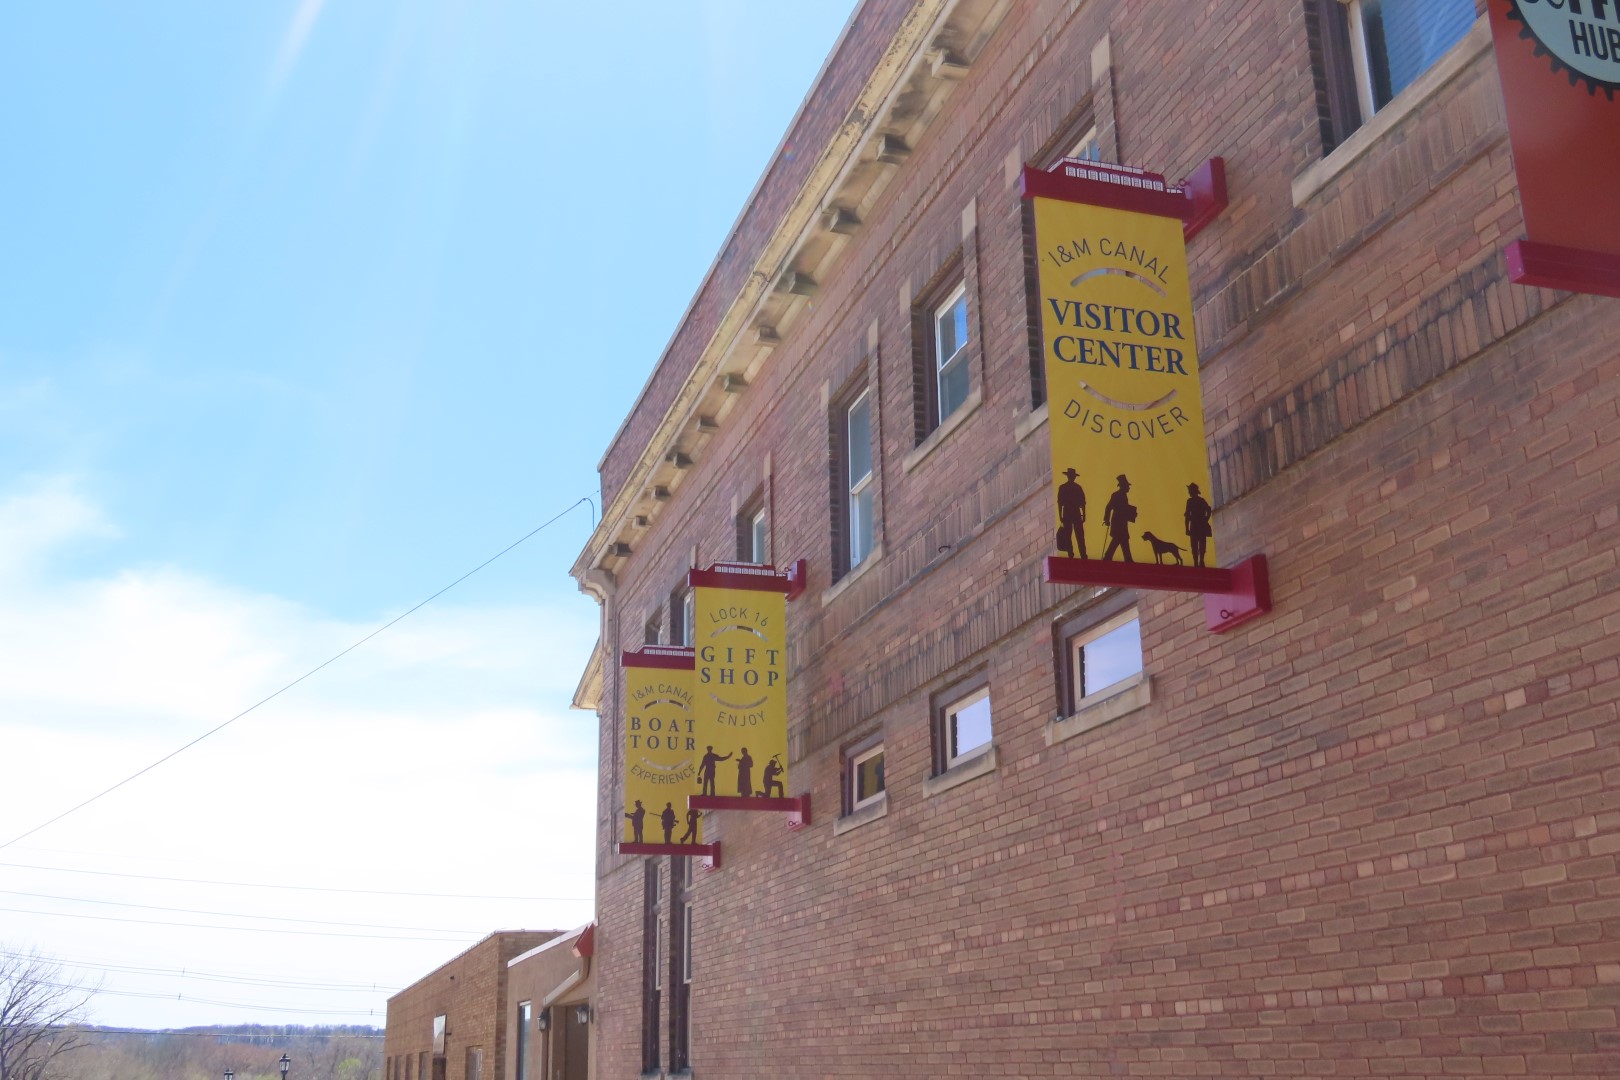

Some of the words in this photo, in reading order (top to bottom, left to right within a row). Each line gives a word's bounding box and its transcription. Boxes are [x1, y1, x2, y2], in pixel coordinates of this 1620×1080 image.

[1048, 238, 1091, 267] I&M
[1099, 238, 1169, 284] CANAL
[1047, 298, 1185, 340] VISITOR
[1053, 336, 1188, 376] CENTER
[1063, 399, 1189, 441] DISCOVER
[709, 607, 748, 623] LOCK
[754, 612, 769, 627] 16
[700, 646, 779, 666] GIFT
[700, 667, 779, 687] SHOP
[631, 685, 654, 702] I&M
[658, 684, 693, 705] CANAL
[630, 717, 695, 733] BOAT
[717, 711, 766, 727] ENJOY
[630, 734, 695, 751] TOUR
[630, 764, 696, 785] EXPERIENCE
